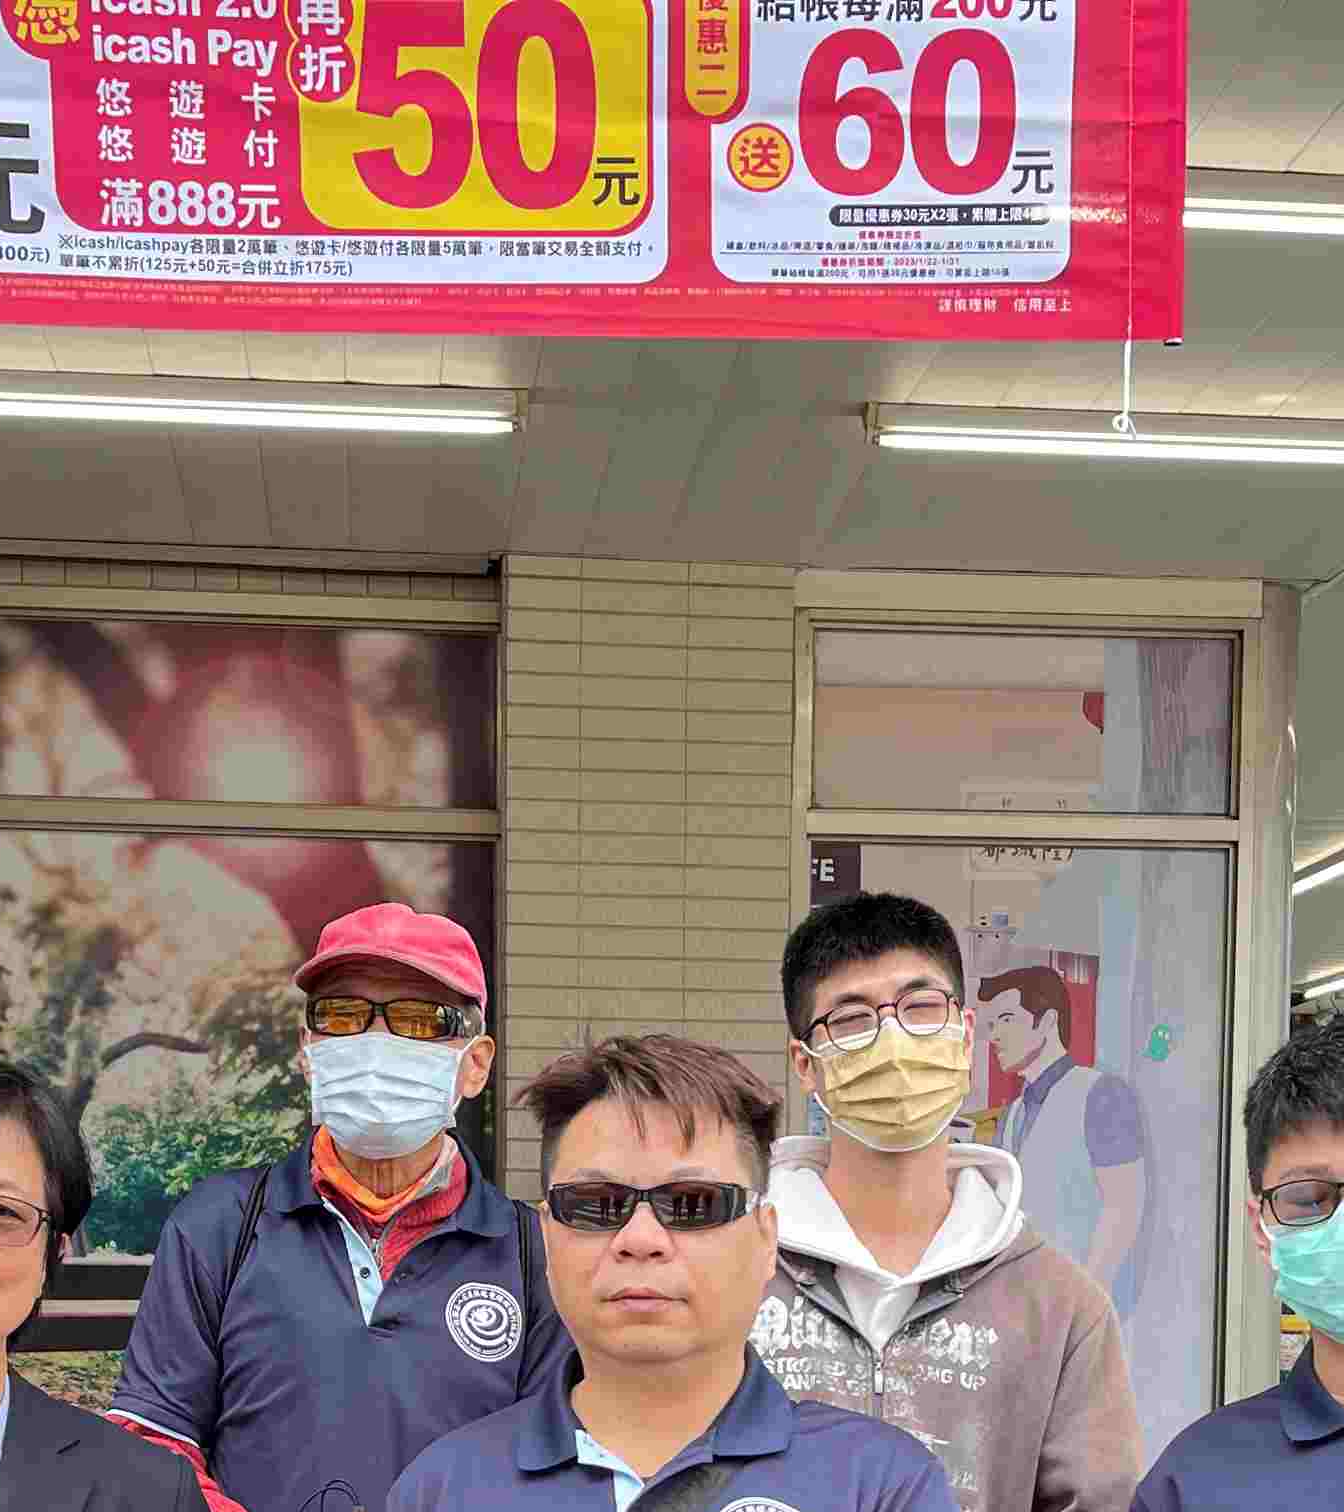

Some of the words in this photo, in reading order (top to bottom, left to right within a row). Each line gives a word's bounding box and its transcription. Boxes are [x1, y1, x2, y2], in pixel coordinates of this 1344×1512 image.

[92, 26, 196, 65] icash
[207, 29, 278, 77] Pay
[96, 79, 276, 122] 悠遊卡
[97, 125, 279, 168] 悠遊付
[739, 138, 782, 178] 送
[99, 178, 281, 230] 滿888元
